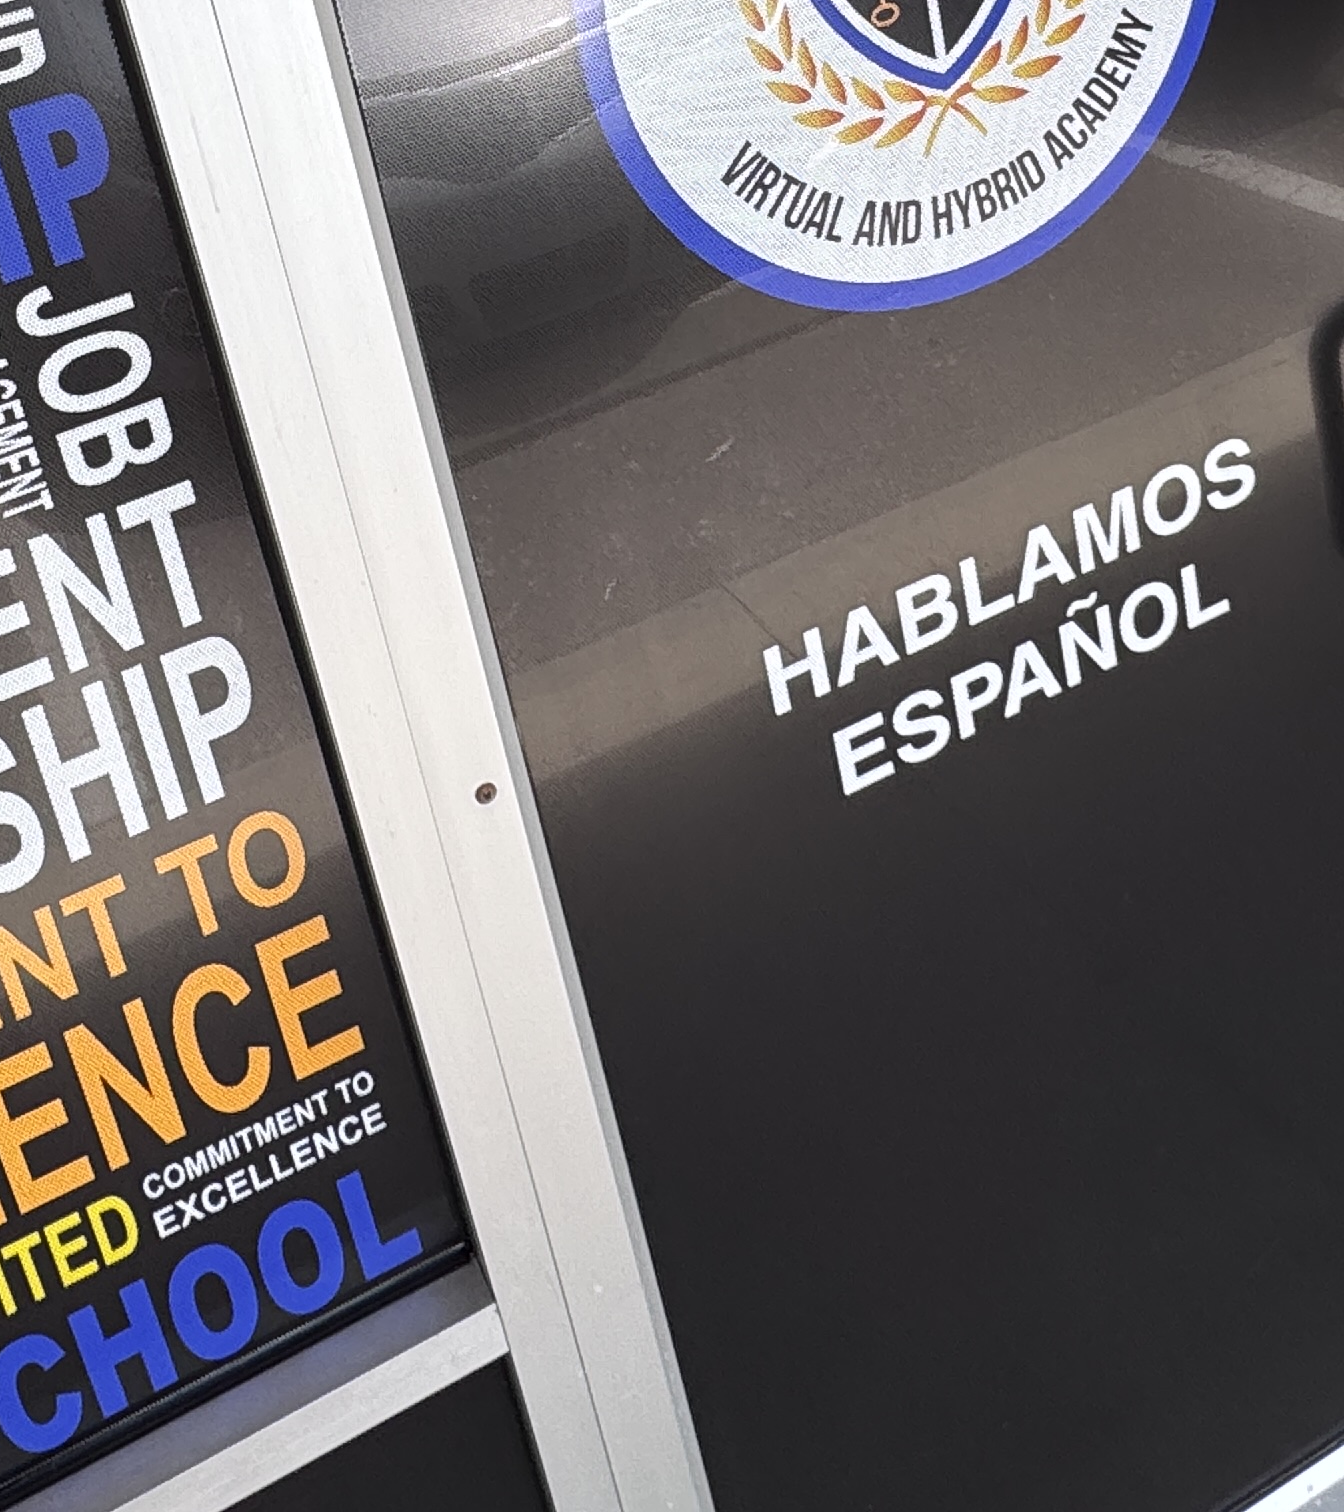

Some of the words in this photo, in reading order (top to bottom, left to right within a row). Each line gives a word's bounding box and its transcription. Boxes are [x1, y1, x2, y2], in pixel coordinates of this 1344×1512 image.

[719, 140, 844, 245] VIRTUAL
[854, 200, 923, 248] AND
[930, 147, 1048, 240] HYBRID
[1042, 8, 1155, 170] ACADEMY
[15, 285, 176, 489] JOB
[762, 438, 1257, 716] HABLAMOS
[832, 564, 1231, 796] ESPAÑOL
[154, 809, 306, 938] TO
[142, 1091, 330, 1200] COMMITMENT
[334, 1069, 375, 1112] TO
[152, 1102, 387, 1241] EXCELLENCE
